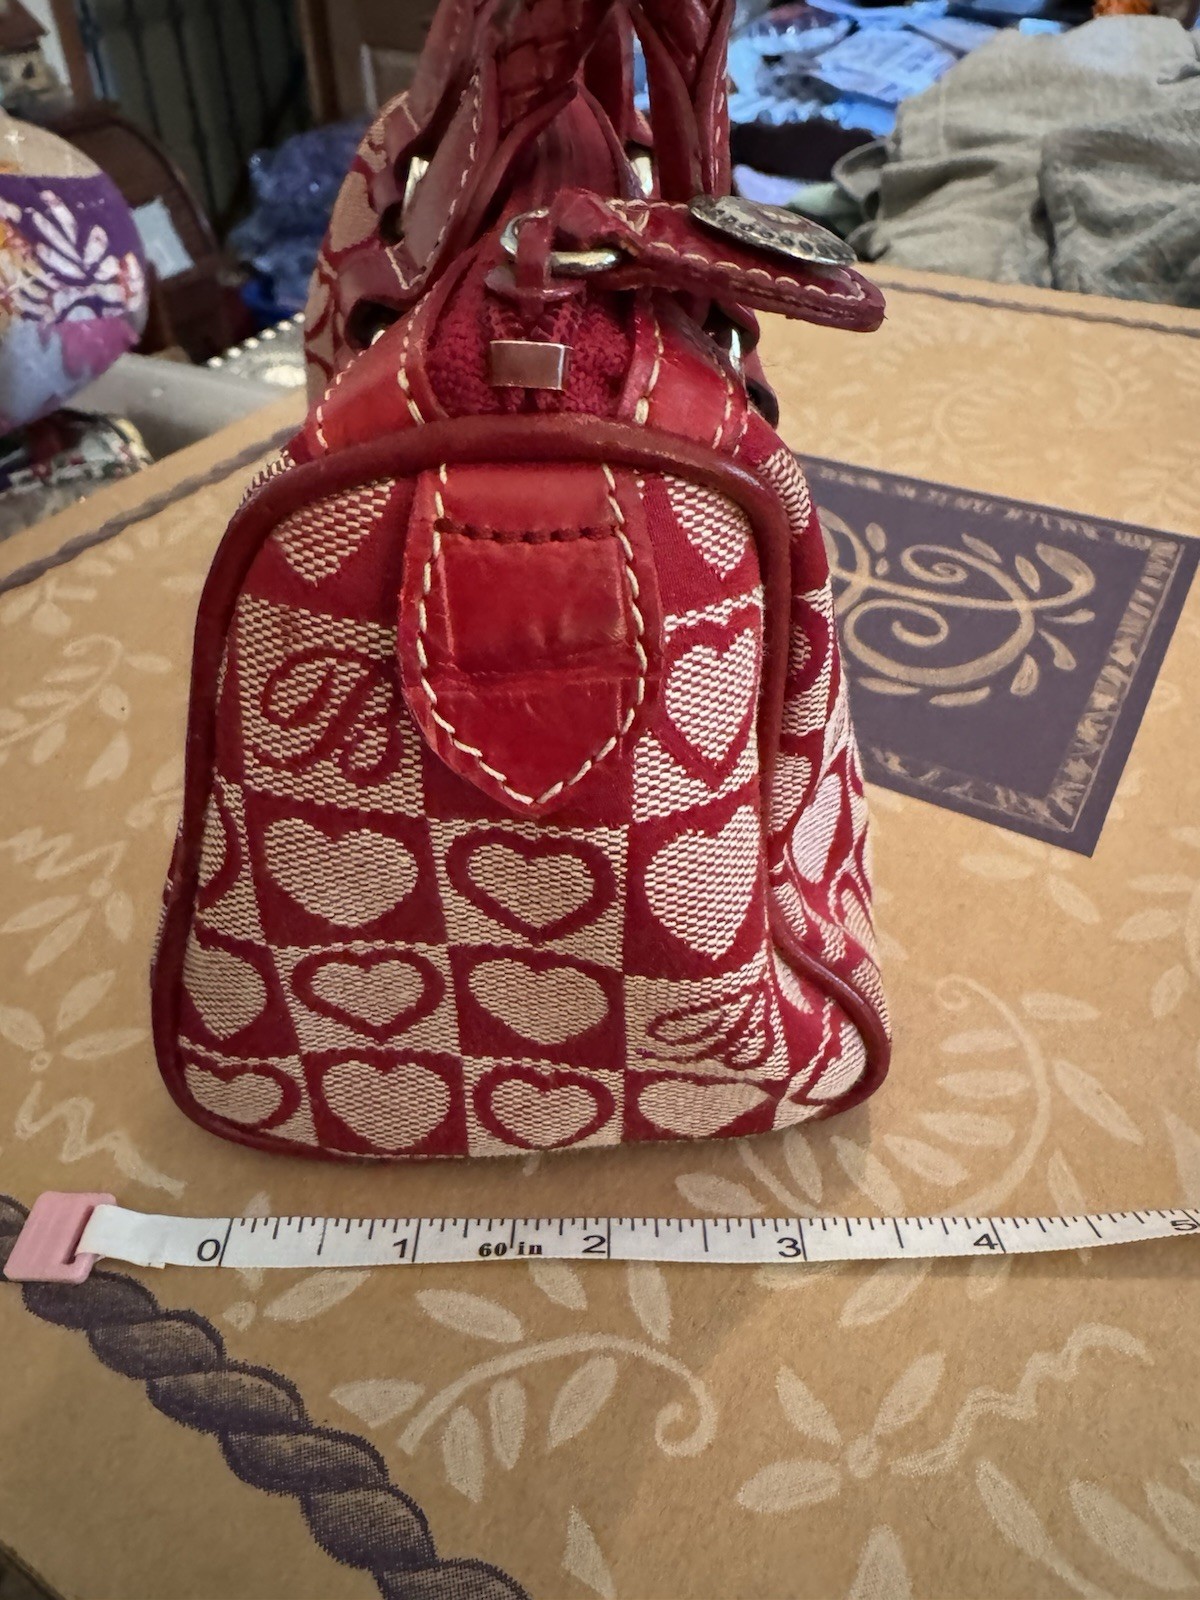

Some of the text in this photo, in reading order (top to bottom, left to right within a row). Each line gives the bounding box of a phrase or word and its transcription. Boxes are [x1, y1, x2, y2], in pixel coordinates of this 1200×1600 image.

[197, 1219, 1199, 1262] 0 1 60 in 2 3 4 5
